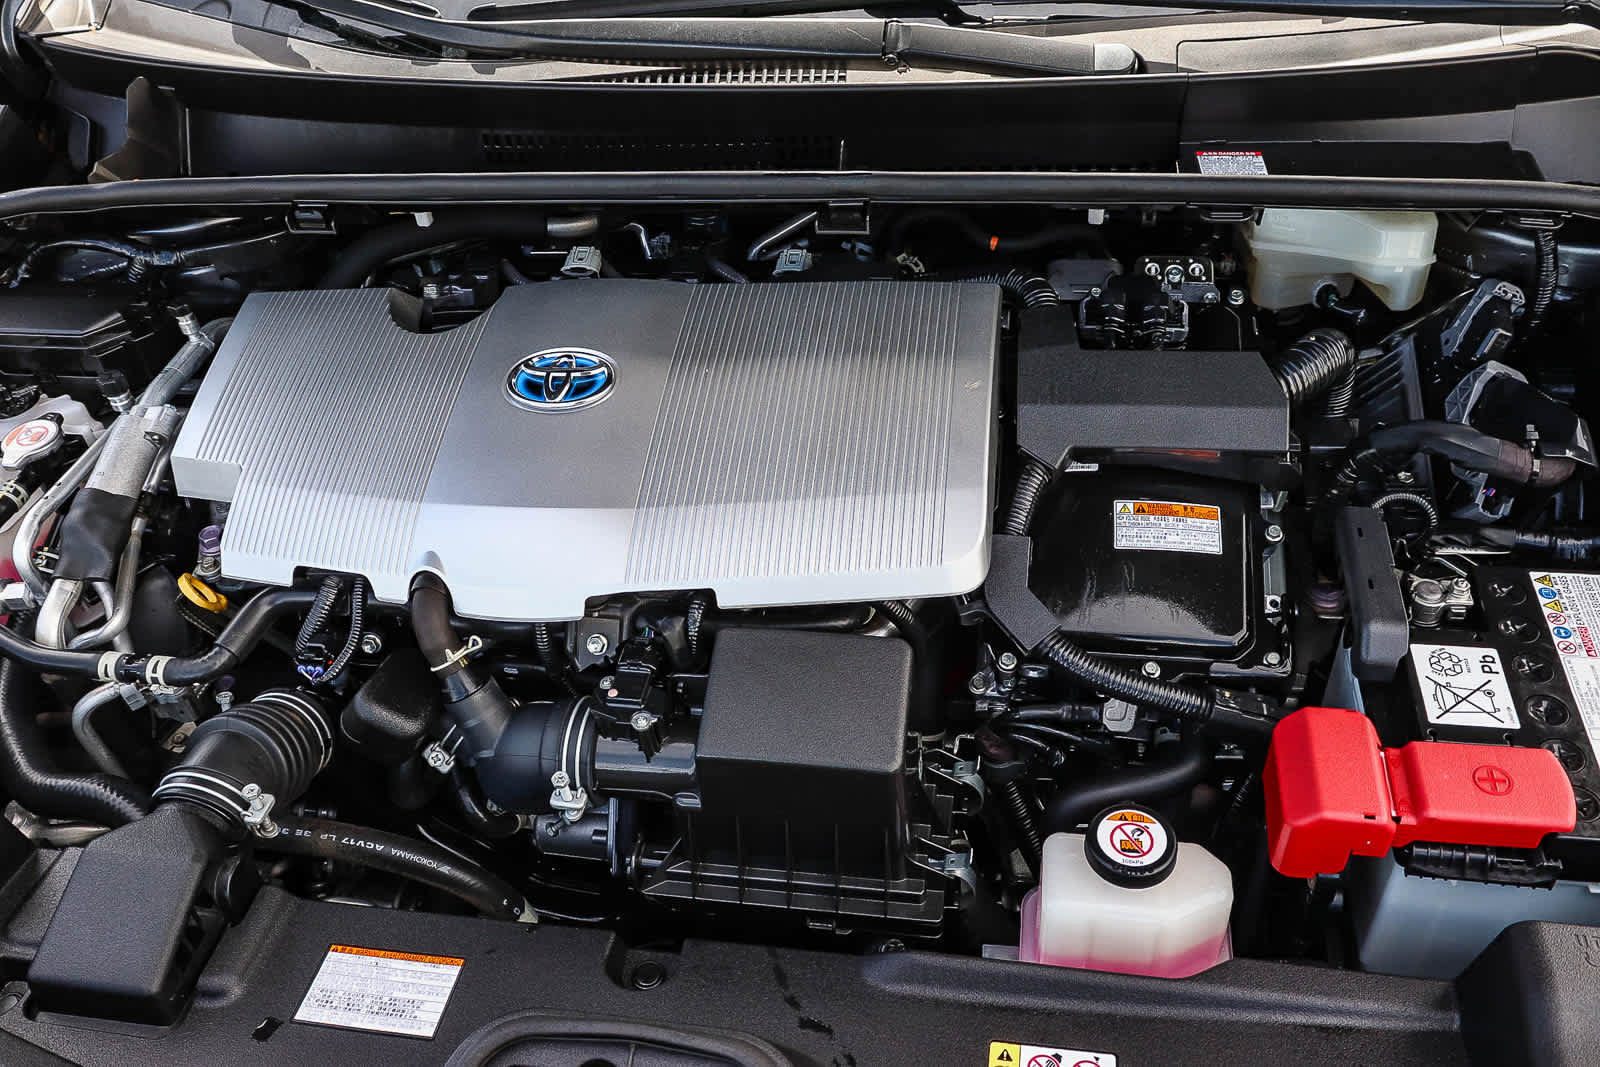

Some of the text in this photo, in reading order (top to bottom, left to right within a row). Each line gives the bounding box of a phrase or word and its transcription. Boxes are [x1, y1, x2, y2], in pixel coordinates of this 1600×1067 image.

[1557, 575, 1573, 594] GASES
[1564, 595, 1585, 626] EXPLOSIVE
[1577, 626, 1595, 650] DANGER
[1479, 654, 1499, 675] Pb
[295, 828, 312, 837] 3E
[319, 833, 336, 842] LP
[340, 837, 384, 851] ACV17
[391, 847, 438, 869] YOKOHAMA
